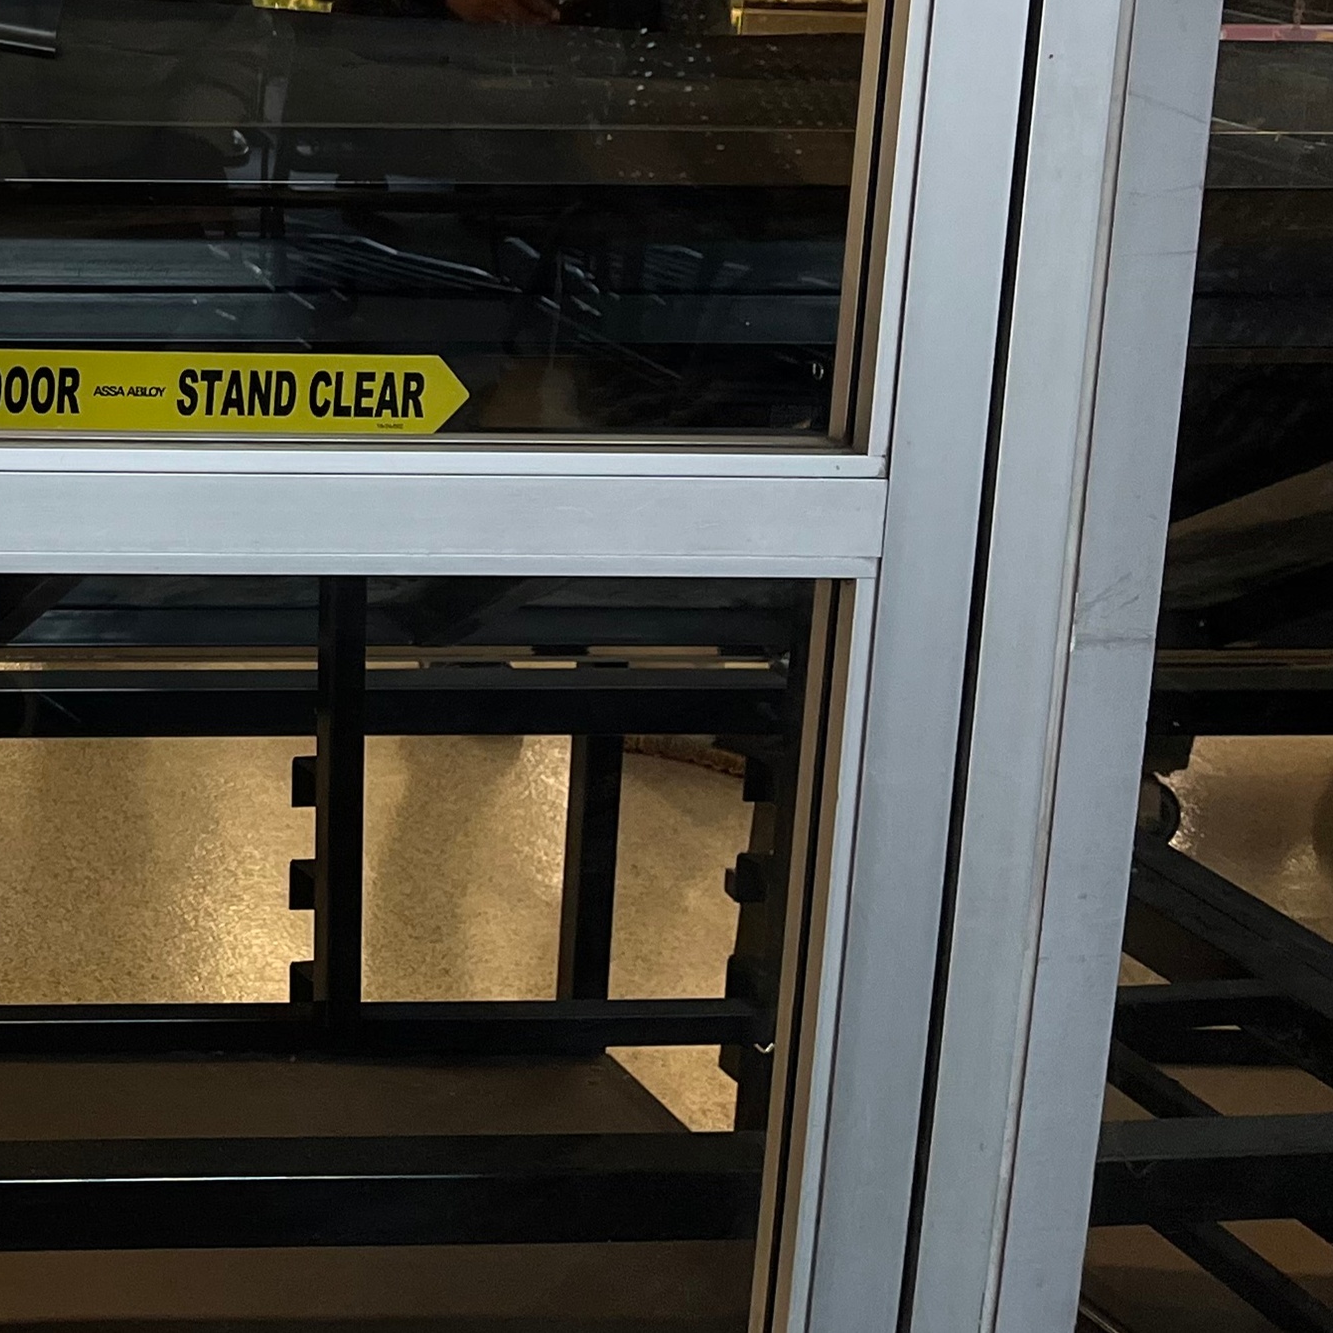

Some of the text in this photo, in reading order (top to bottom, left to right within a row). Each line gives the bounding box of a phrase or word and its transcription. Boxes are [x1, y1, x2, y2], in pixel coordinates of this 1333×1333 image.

[93, 386, 124, 396] ASSA
[127, 386, 165, 398] ABLOY
[177, 369, 296, 415] STAND
[309, 371, 425, 418] CLEAR
